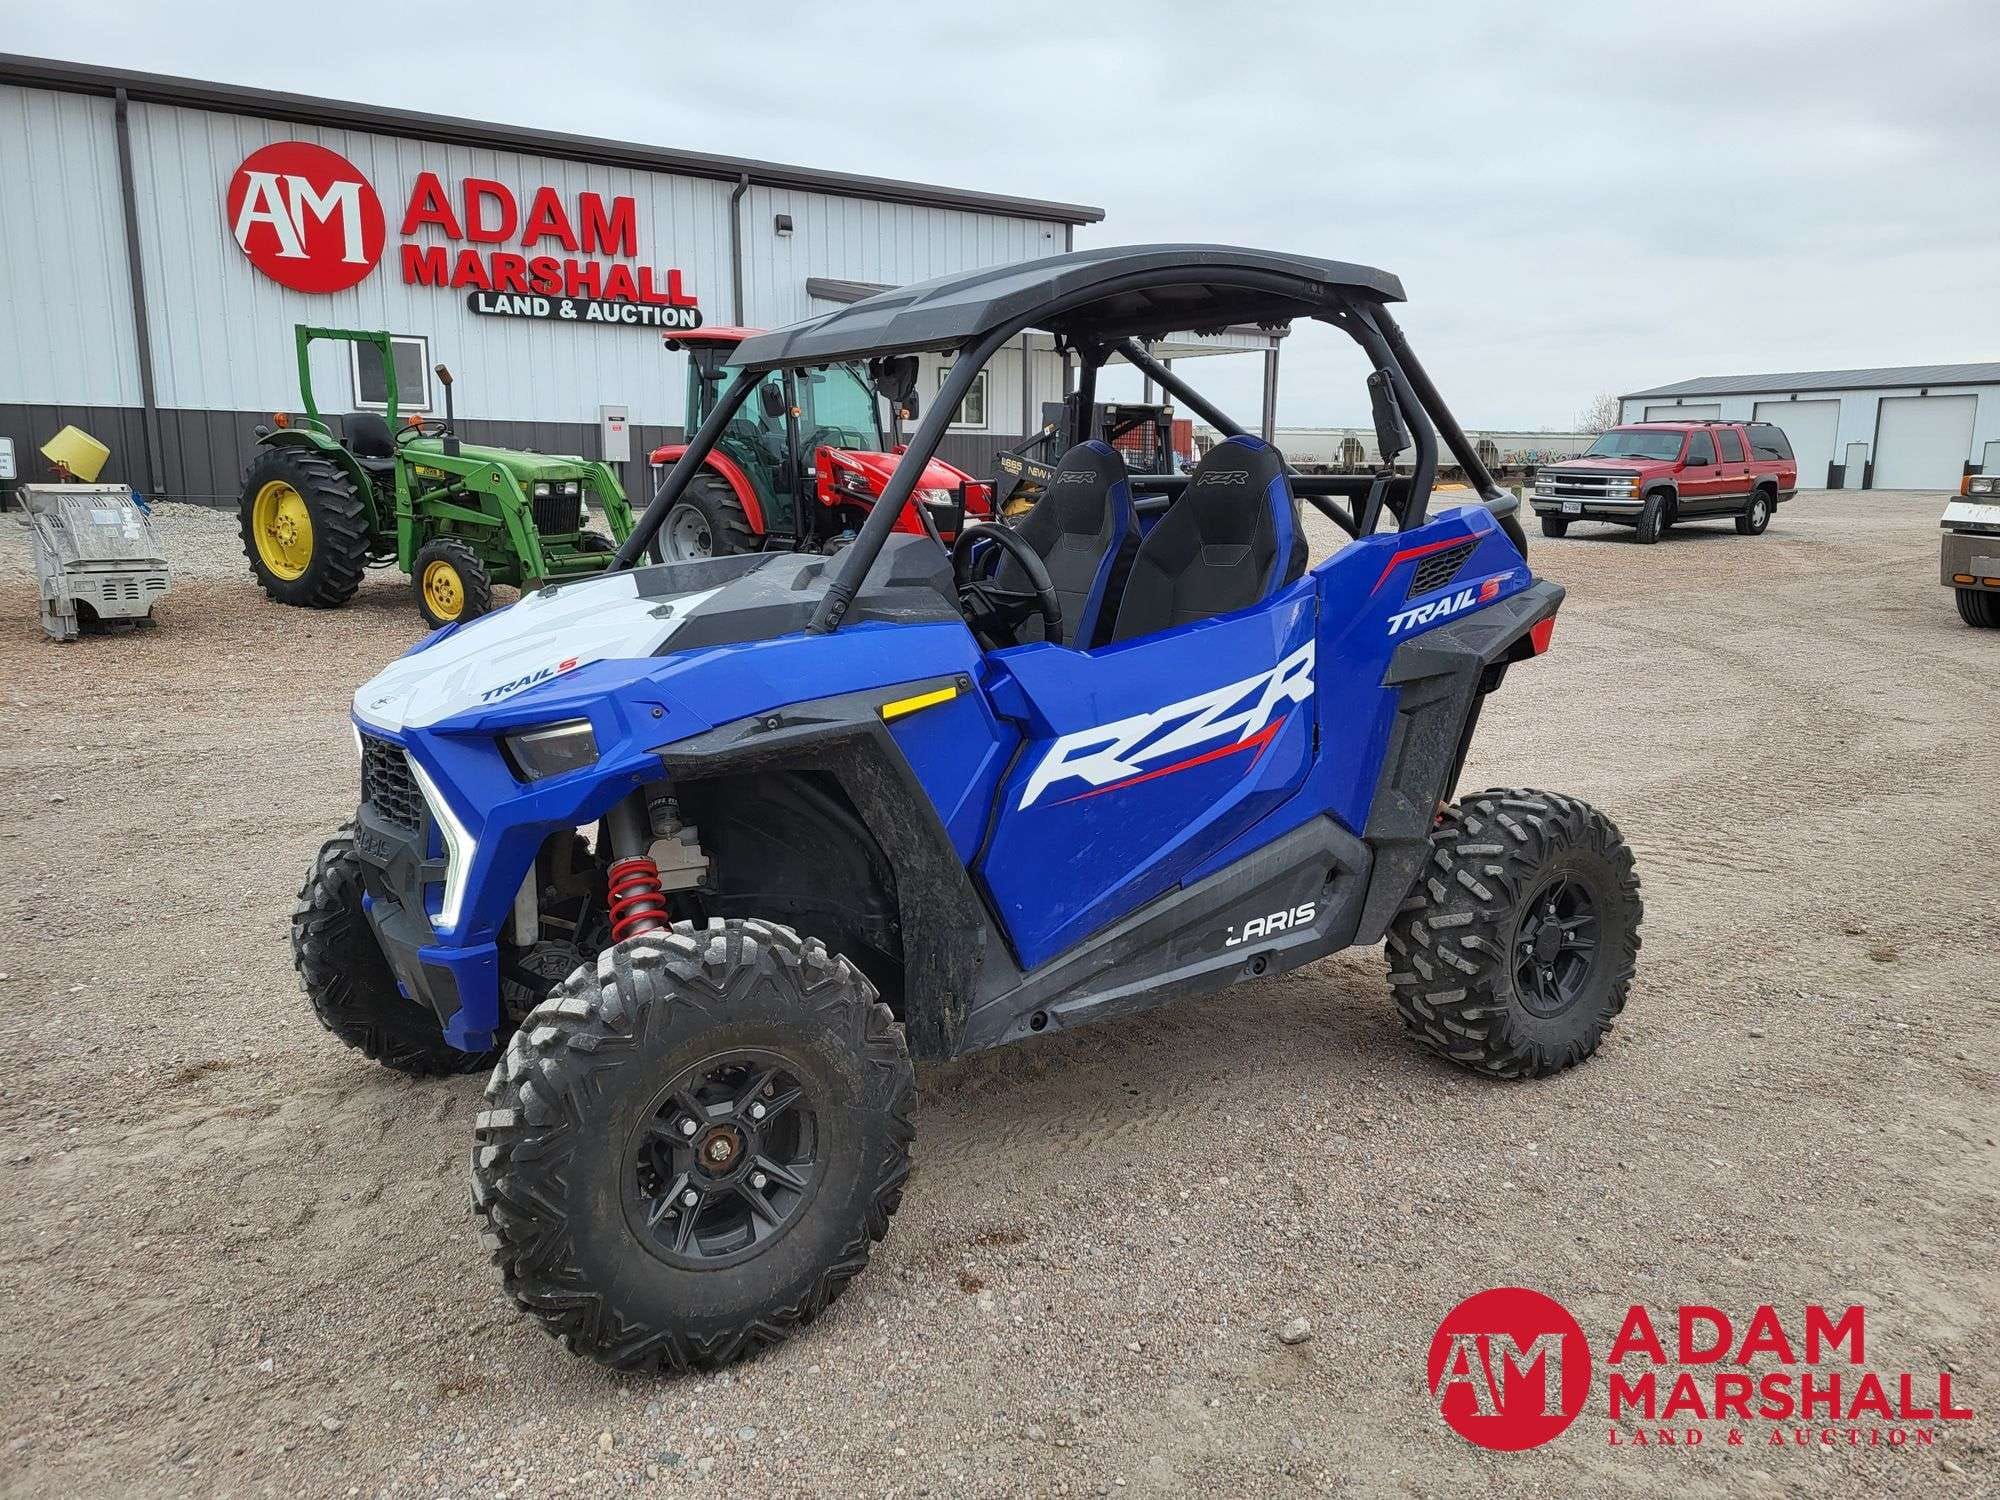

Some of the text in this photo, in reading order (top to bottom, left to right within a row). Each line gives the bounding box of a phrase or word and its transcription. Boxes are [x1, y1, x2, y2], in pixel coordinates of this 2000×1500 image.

[233, 170, 369, 265] AM
[400, 171, 638, 257] ADAM
[402, 243, 698, 306] MARSHALL
[477, 293, 696, 328] LAND & AUCTION
[1028, 466, 1047, 480] NEW
[1057, 471, 1097, 484] RZR
[1197, 471, 1249, 486] RZR
[1387, 588, 1476, 636] TRAIL
[481, 656, 579, 702] TRAIL S
[1018, 638, 1315, 812] RZR
